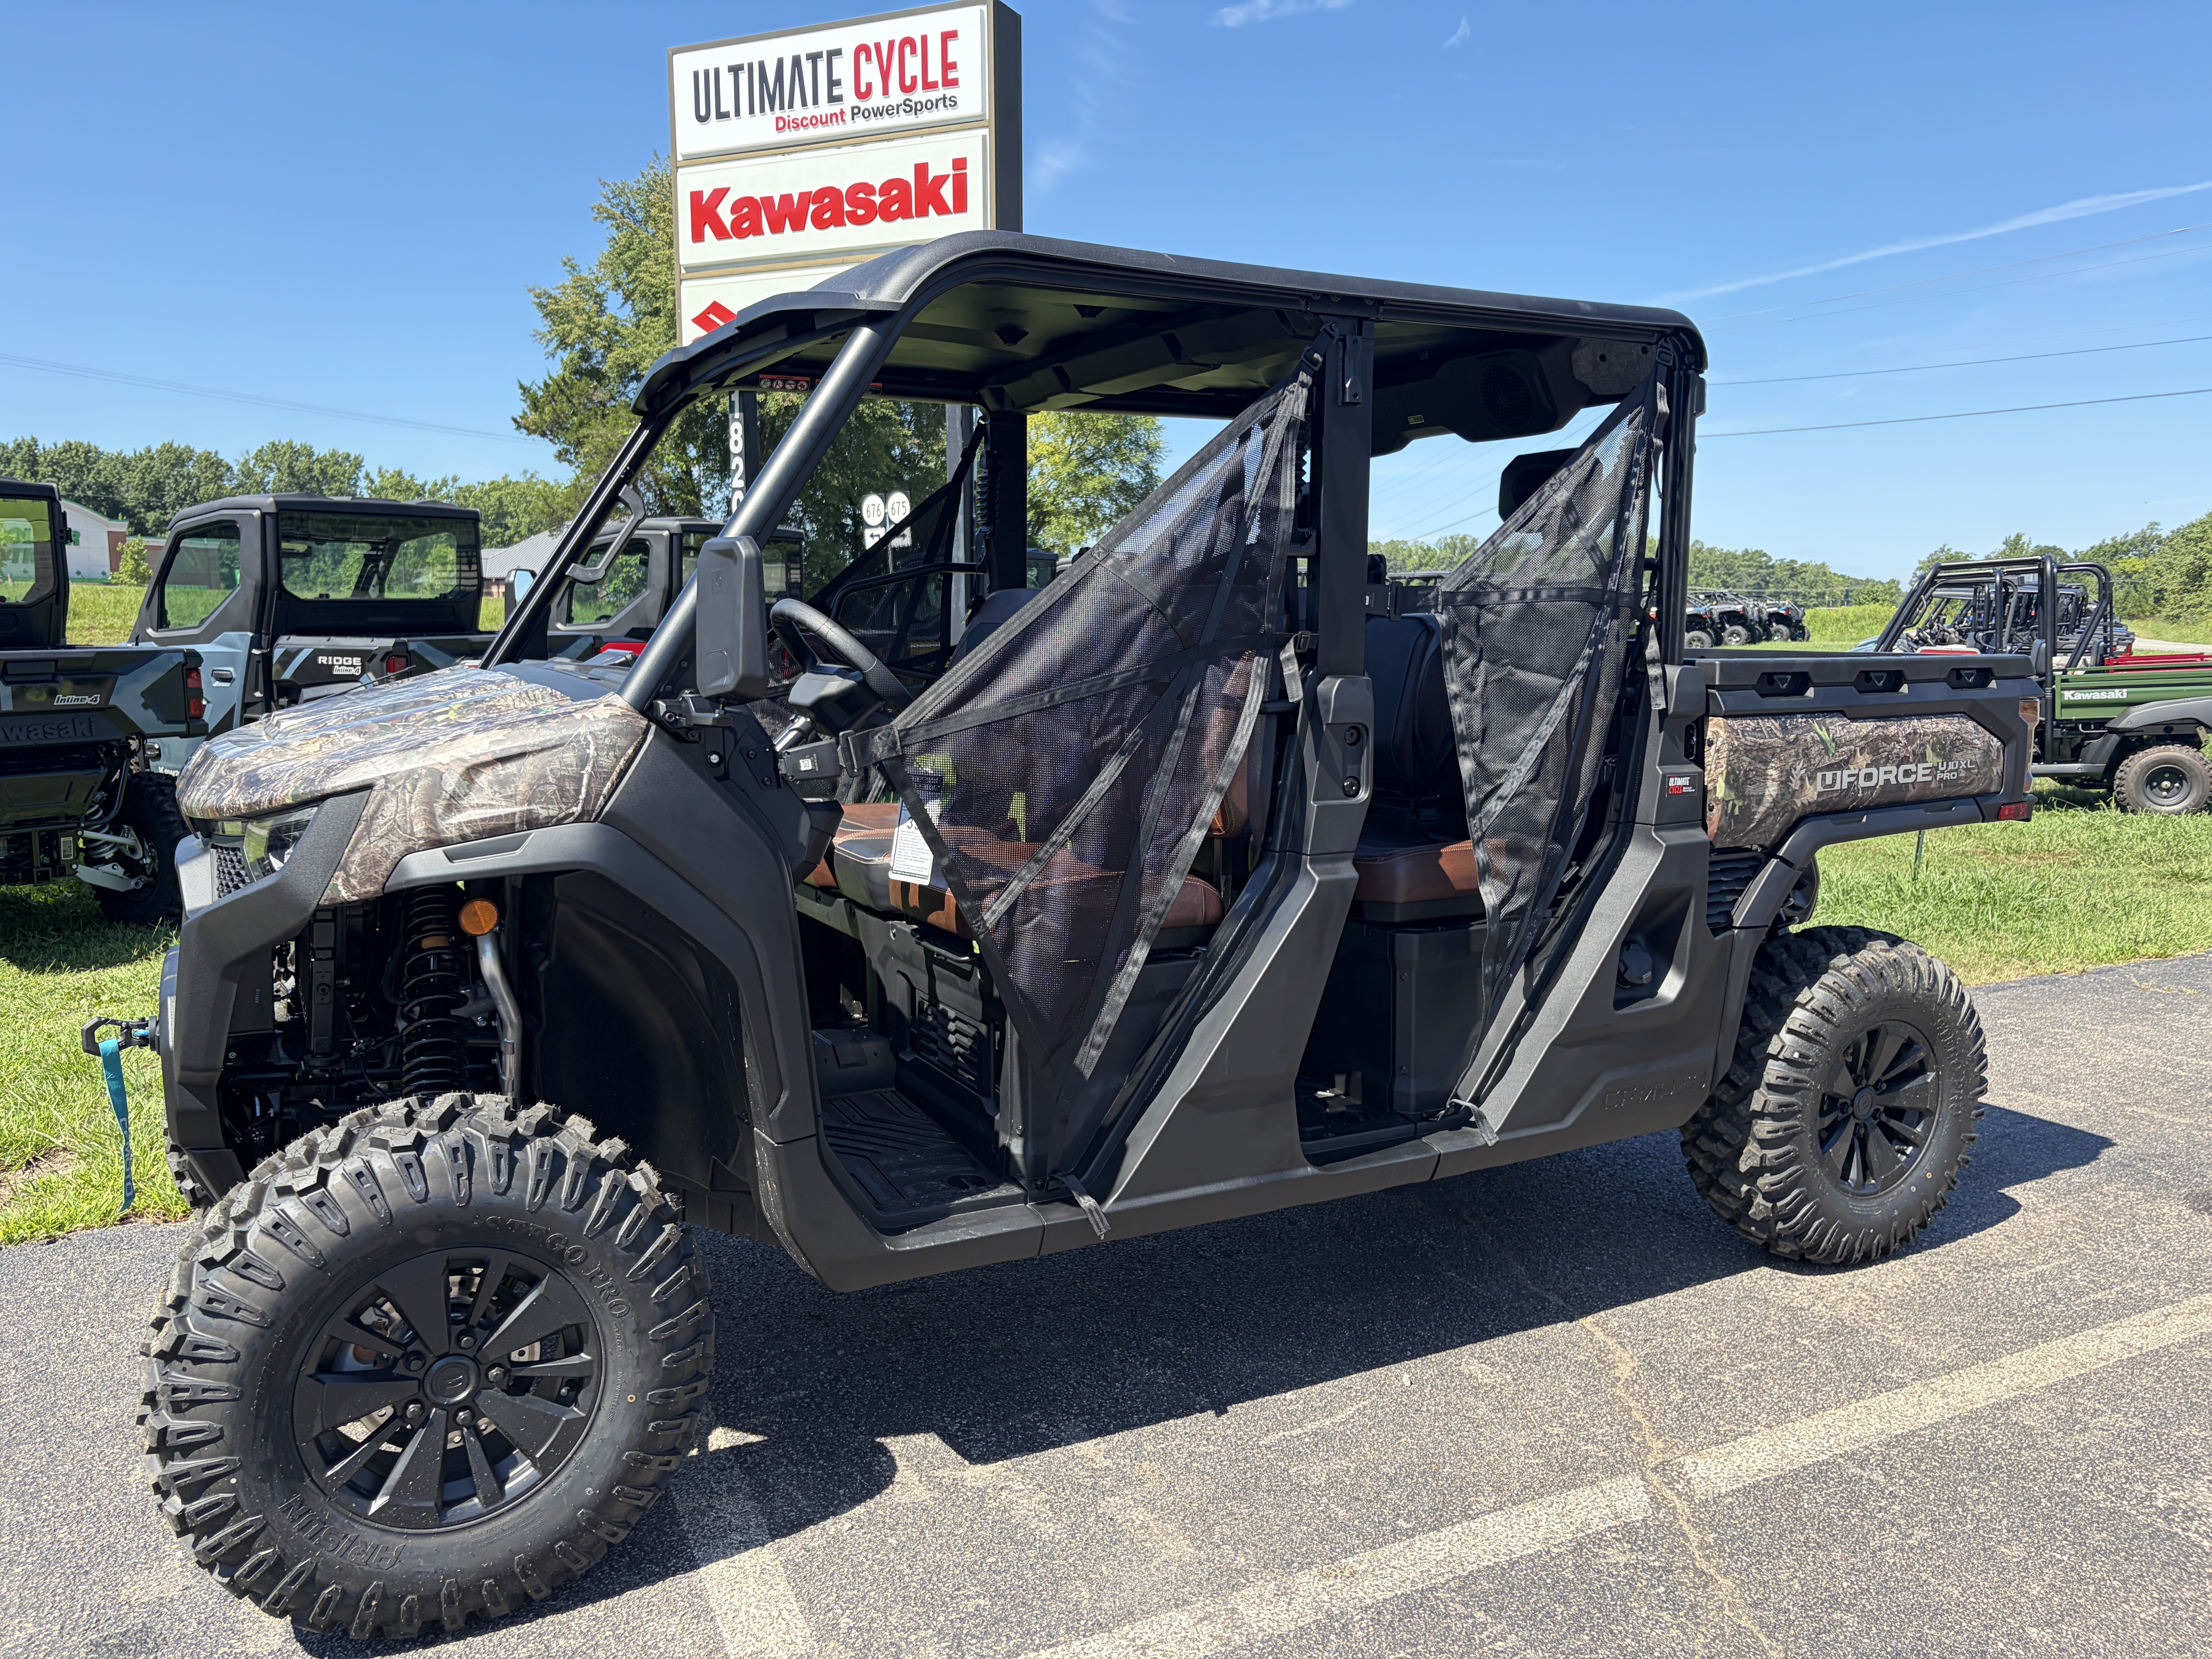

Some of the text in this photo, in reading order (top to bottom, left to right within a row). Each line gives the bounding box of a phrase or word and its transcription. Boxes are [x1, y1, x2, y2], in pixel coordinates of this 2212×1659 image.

[693, 29, 959, 123] ULTIMATE CYCLE
[775, 93, 958, 132] Discount PowerSports
[689, 157, 968, 243] Kawasaki
[866, 503, 881, 518] 676
[891, 501, 907, 516] 675
[318, 656, 362, 665] RIDGE
[54, 694, 100, 705] Inline-4
[2064, 689, 2128, 700] Kawasaki
[0, 717, 96, 742] wasaki
[1669, 777, 1690, 786] ULTIMATE
[1936, 772, 1958, 781] PRO
[1669, 786, 1683, 794] CYCLE
[582, 1261, 630, 1318] PRO
